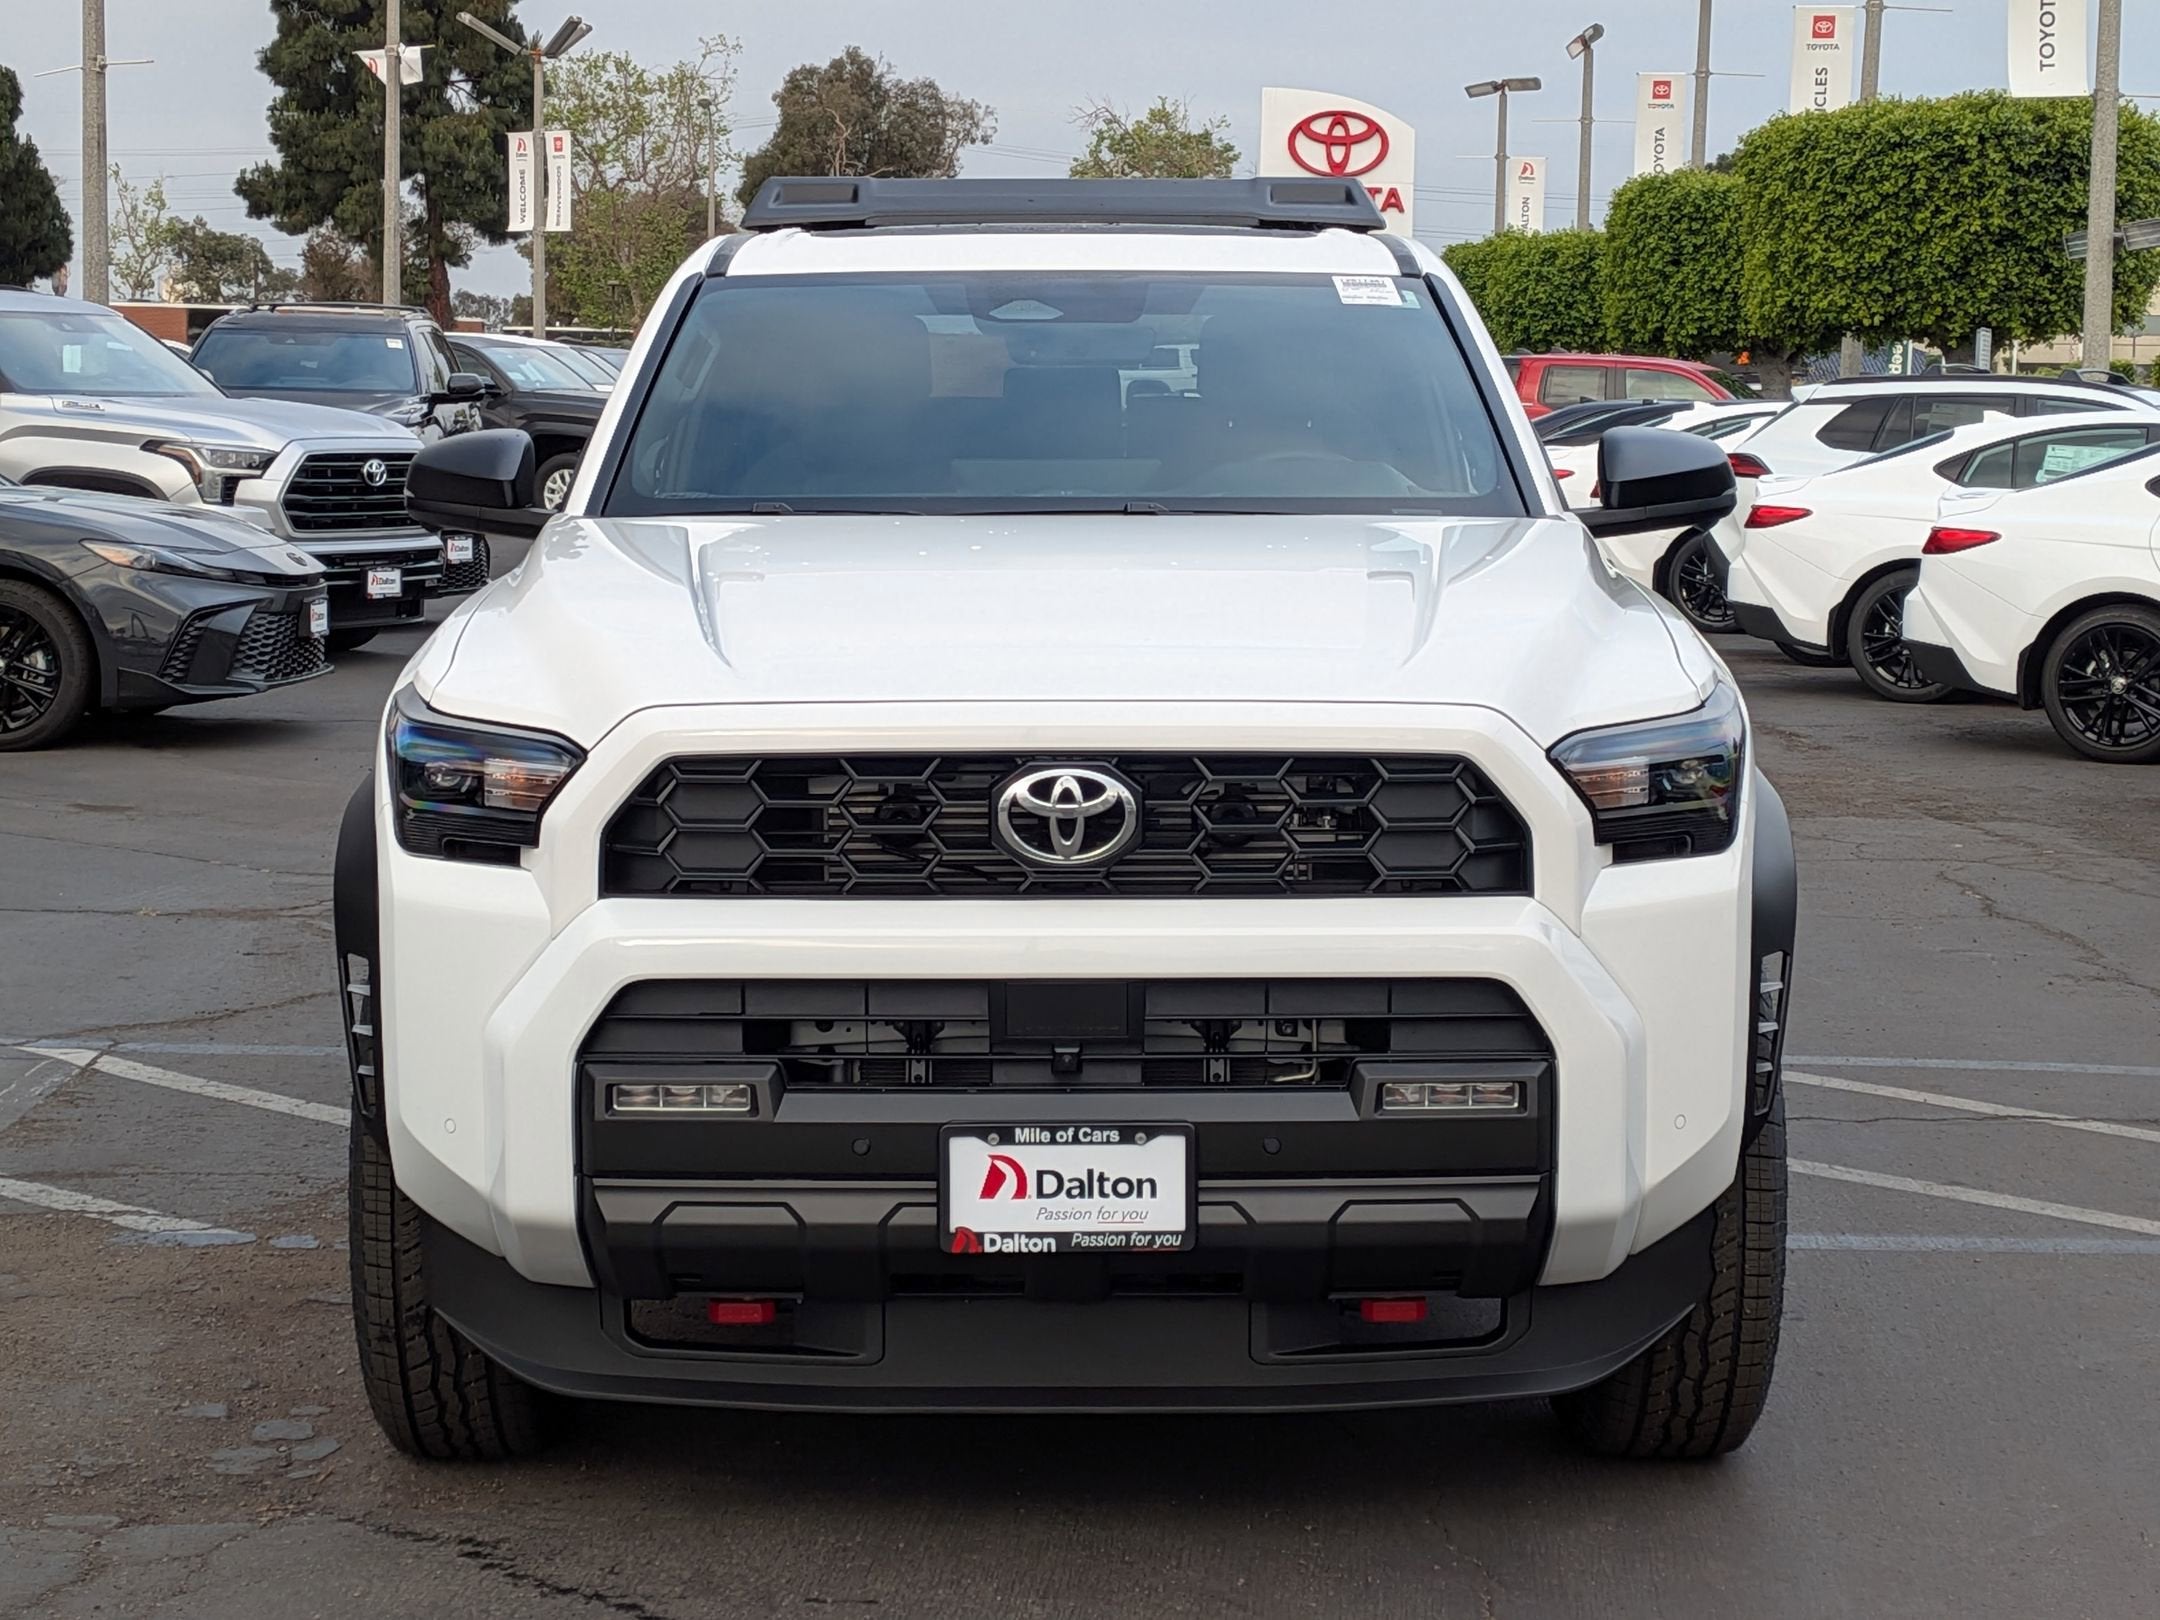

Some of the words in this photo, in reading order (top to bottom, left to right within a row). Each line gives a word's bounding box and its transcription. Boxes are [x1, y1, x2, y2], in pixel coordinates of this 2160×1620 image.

[1806, 43, 1840, 51] TOYOTA
[2039, 0, 2056, 72] TOYOT
[1814, 67, 1828, 112] ICLES
[1653, 127, 1665, 174] OYOTA
[519, 169, 527, 224] WELCOME
[1365, 187, 1405, 213] TA
[1888, 342, 1903, 374] eep
[1014, 1127, 1050, 1144] Mile
[1056, 1127, 1075, 1143] of
[1078, 1127, 1120, 1144] Cars
[1036, 1168, 1158, 1200] Dalton
[1036, 1207, 1092, 1221] Passion
[1097, 1206, 1118, 1222] for
[1120, 1208, 1149, 1223] you
[984, 1232, 1056, 1254] Dalton
[1071, 1231, 1126, 1248] Passion
[1129, 1231, 1151, 1248] for
[1151, 1233, 1182, 1249] you
